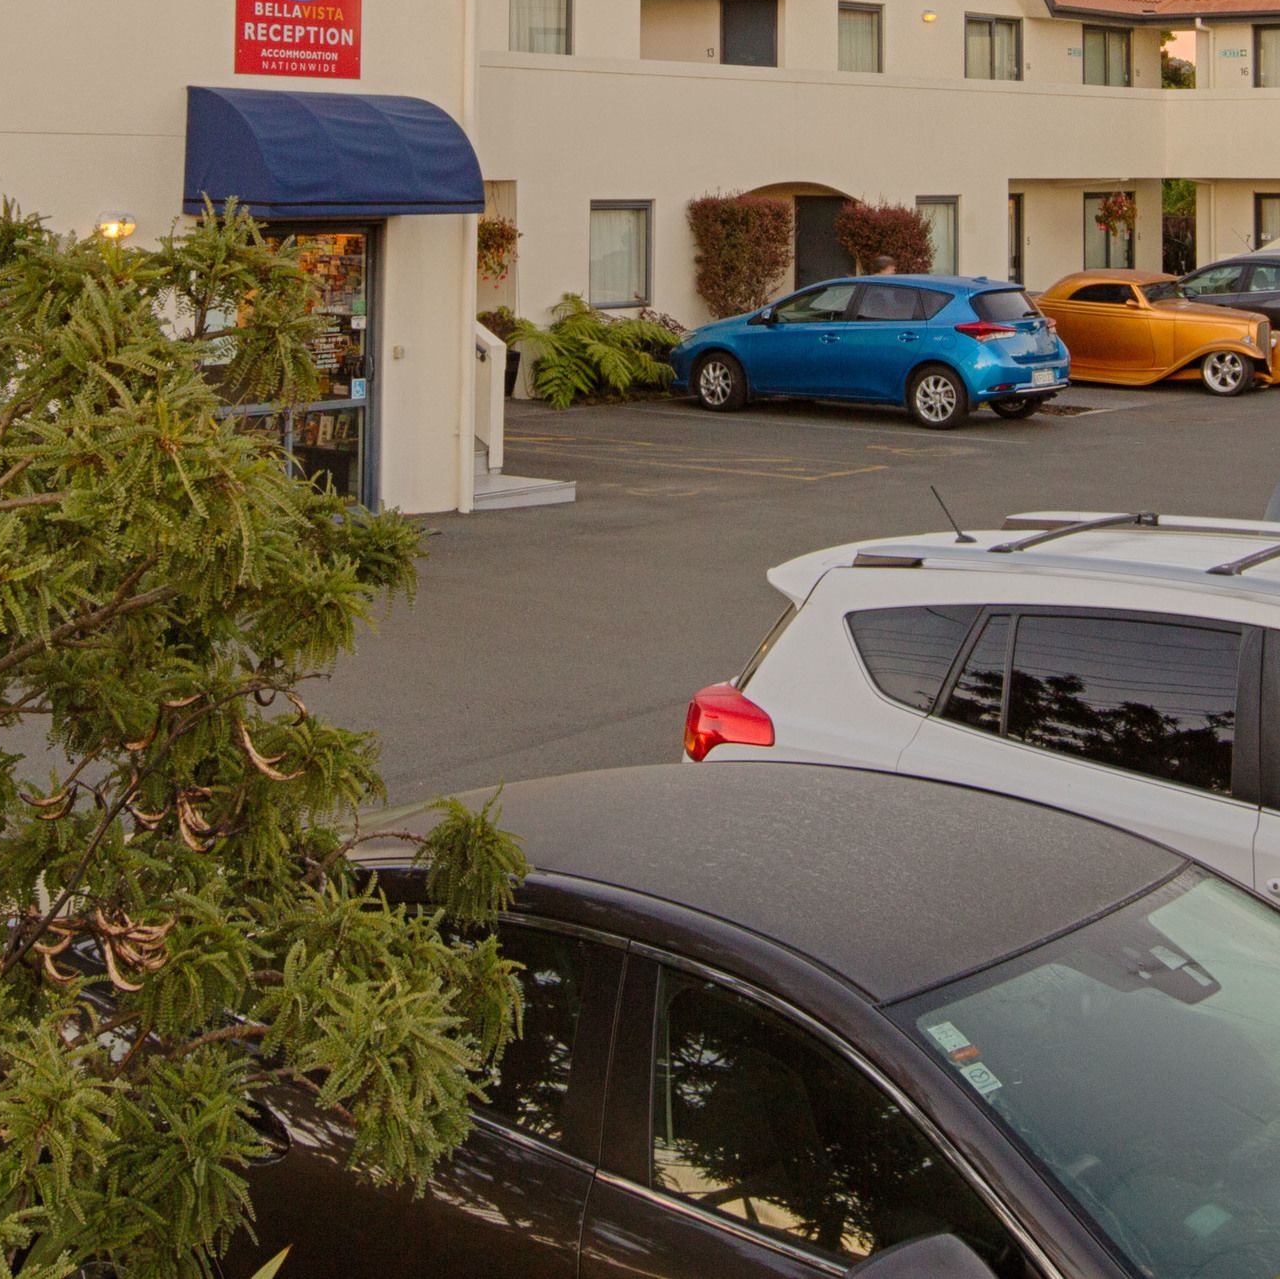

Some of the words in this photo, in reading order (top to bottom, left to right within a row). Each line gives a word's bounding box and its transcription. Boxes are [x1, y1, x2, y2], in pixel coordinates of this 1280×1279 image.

[244, 22, 353, 46] RECEPTION
[261, 48, 338, 61] ACCOMMODATION
[706, 47, 715, 58] 13
[262, 60, 336, 73] NATIONWIDE
[1240, 67, 1249, 76] 16
